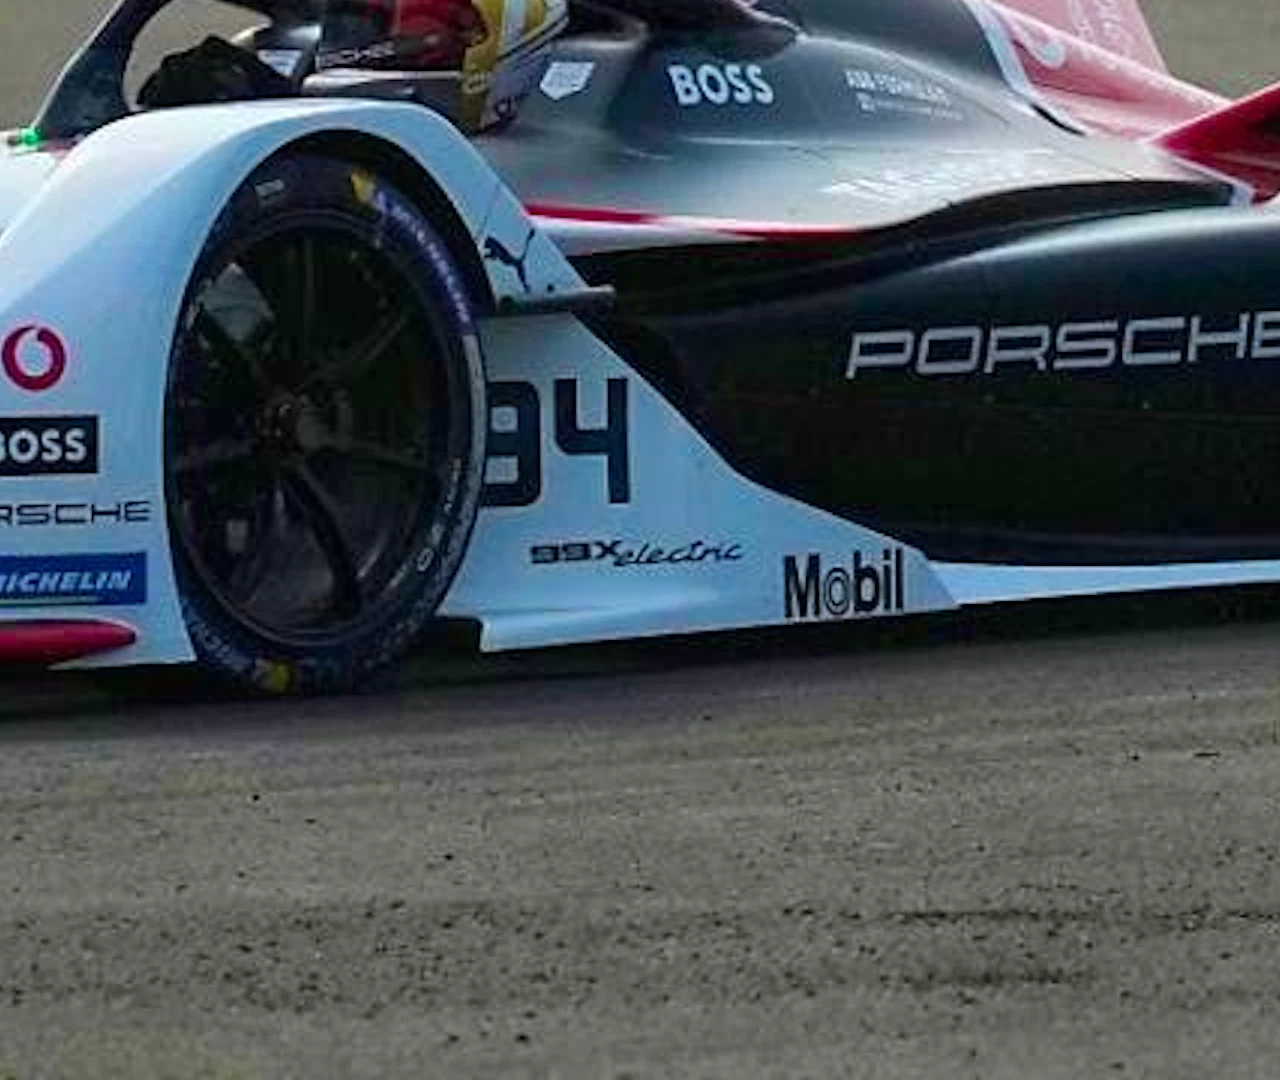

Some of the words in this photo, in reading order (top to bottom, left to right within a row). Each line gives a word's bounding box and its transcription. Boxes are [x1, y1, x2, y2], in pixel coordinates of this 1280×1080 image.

[668, 63, 775, 106] BOSS
[478, 378, 632, 508] 94
[784, 547, 905, 618] Mobil
